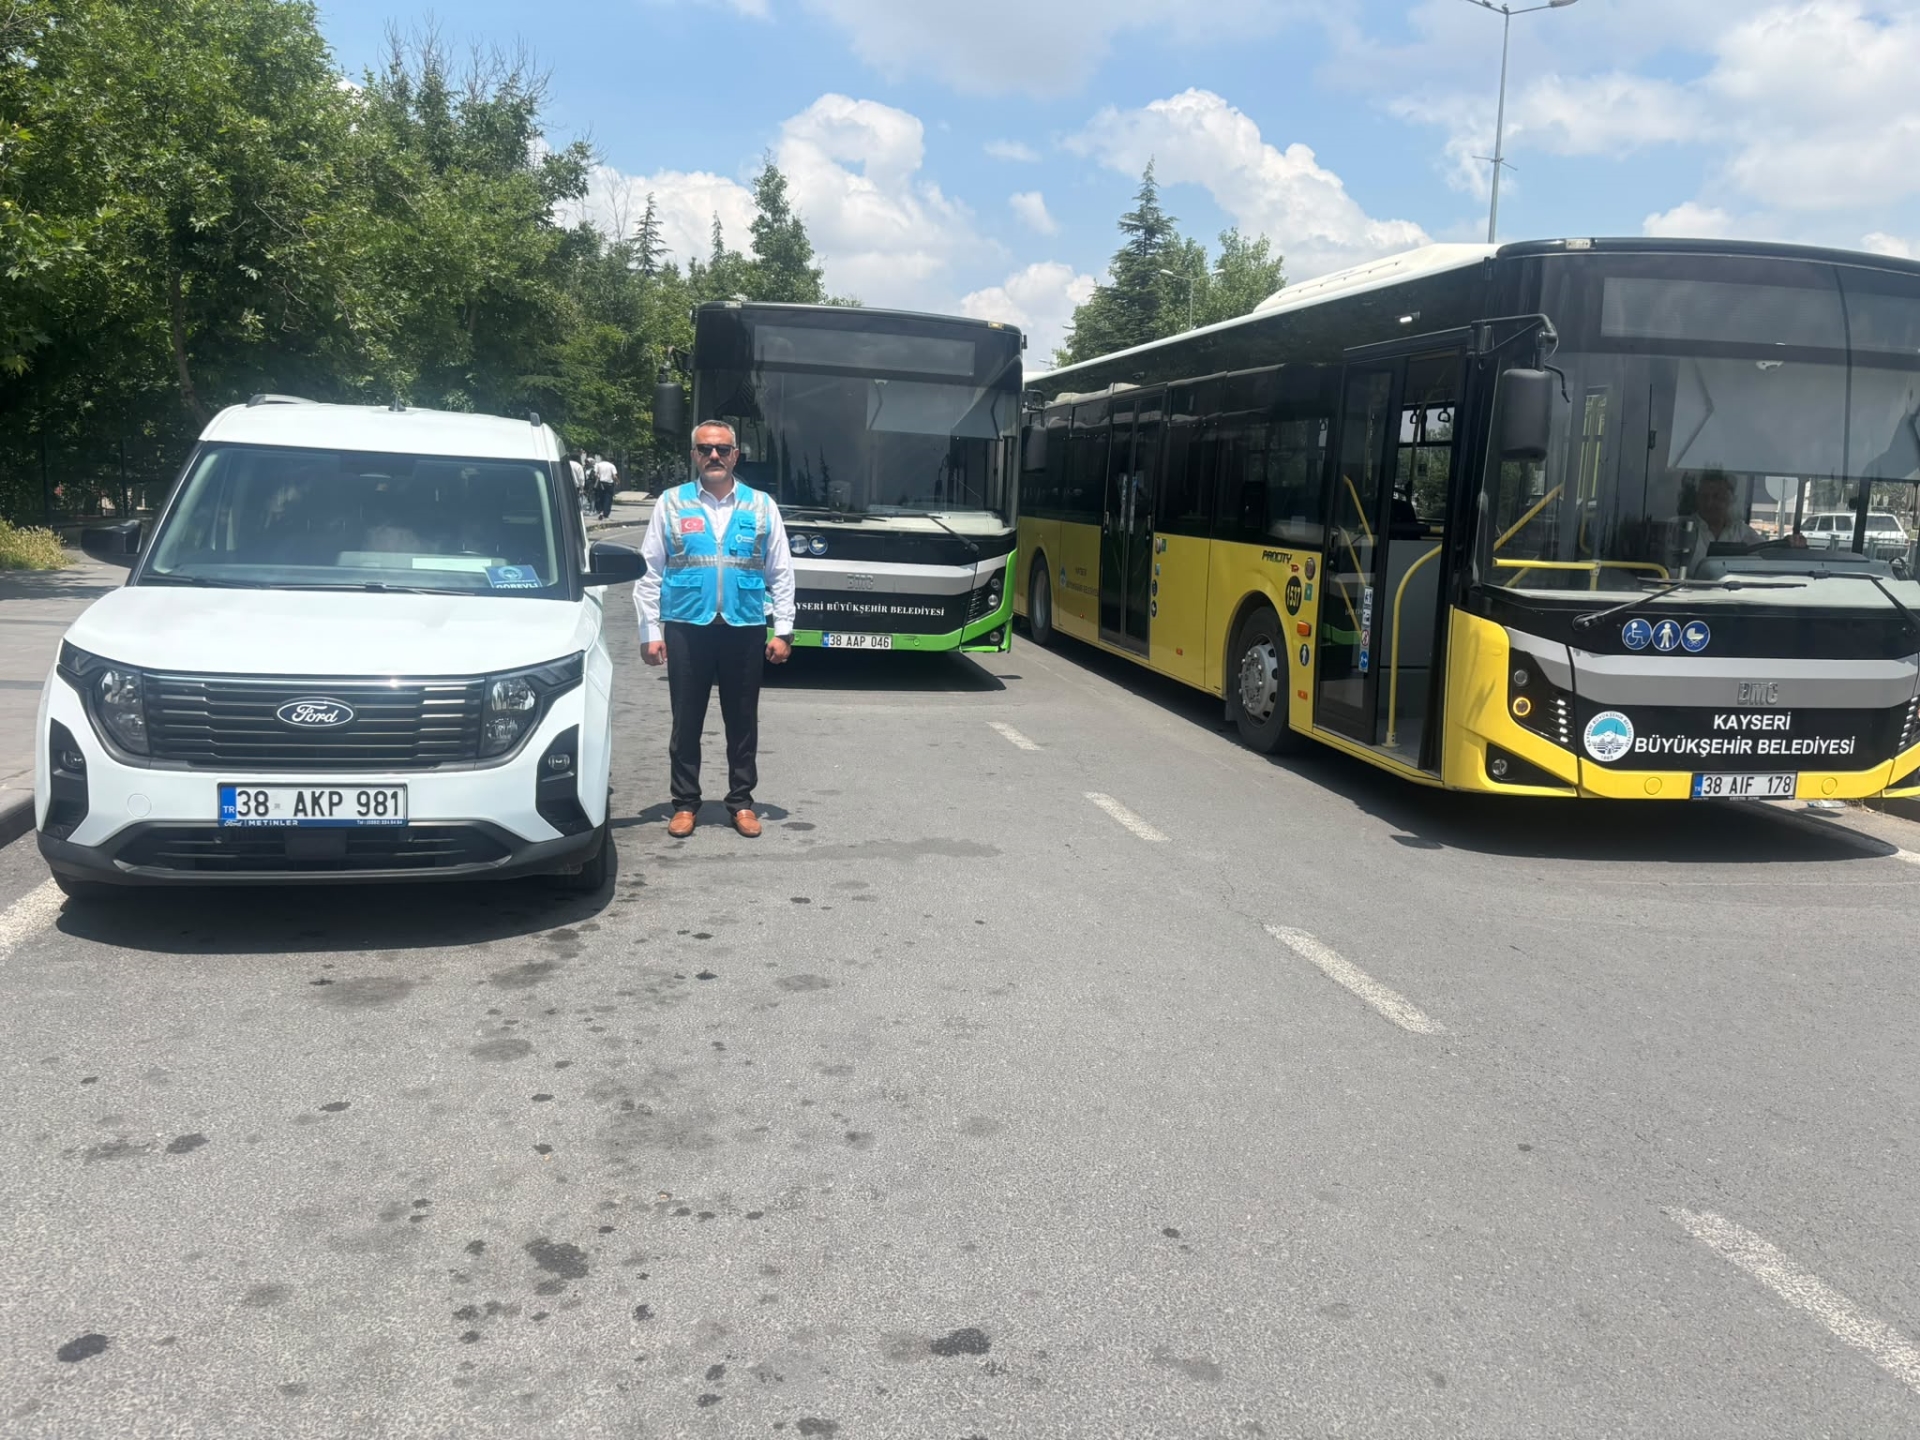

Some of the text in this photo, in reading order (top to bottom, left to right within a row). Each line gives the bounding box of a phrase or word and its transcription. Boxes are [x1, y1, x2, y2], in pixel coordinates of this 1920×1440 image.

[796, 601, 945, 617] YSERİ BÜYÜKŞEHİR BELEDİYESİ
[829, 634, 842, 647] 38
[846, 635, 866, 648] AAP
[871, 636, 890, 649] 046
[291, 704, 339, 723] Ford
[1713, 711, 1792, 731] KAYSERİ
[1634, 734, 1856, 757] BÜYÜKŞEHİR BELEDİYESİ
[1703, 776, 1723, 795] 38
[1728, 776, 1755, 795] AIF
[1767, 775, 1793, 794] 178
[223, 790, 399, 818] TR 38 AKP 981
